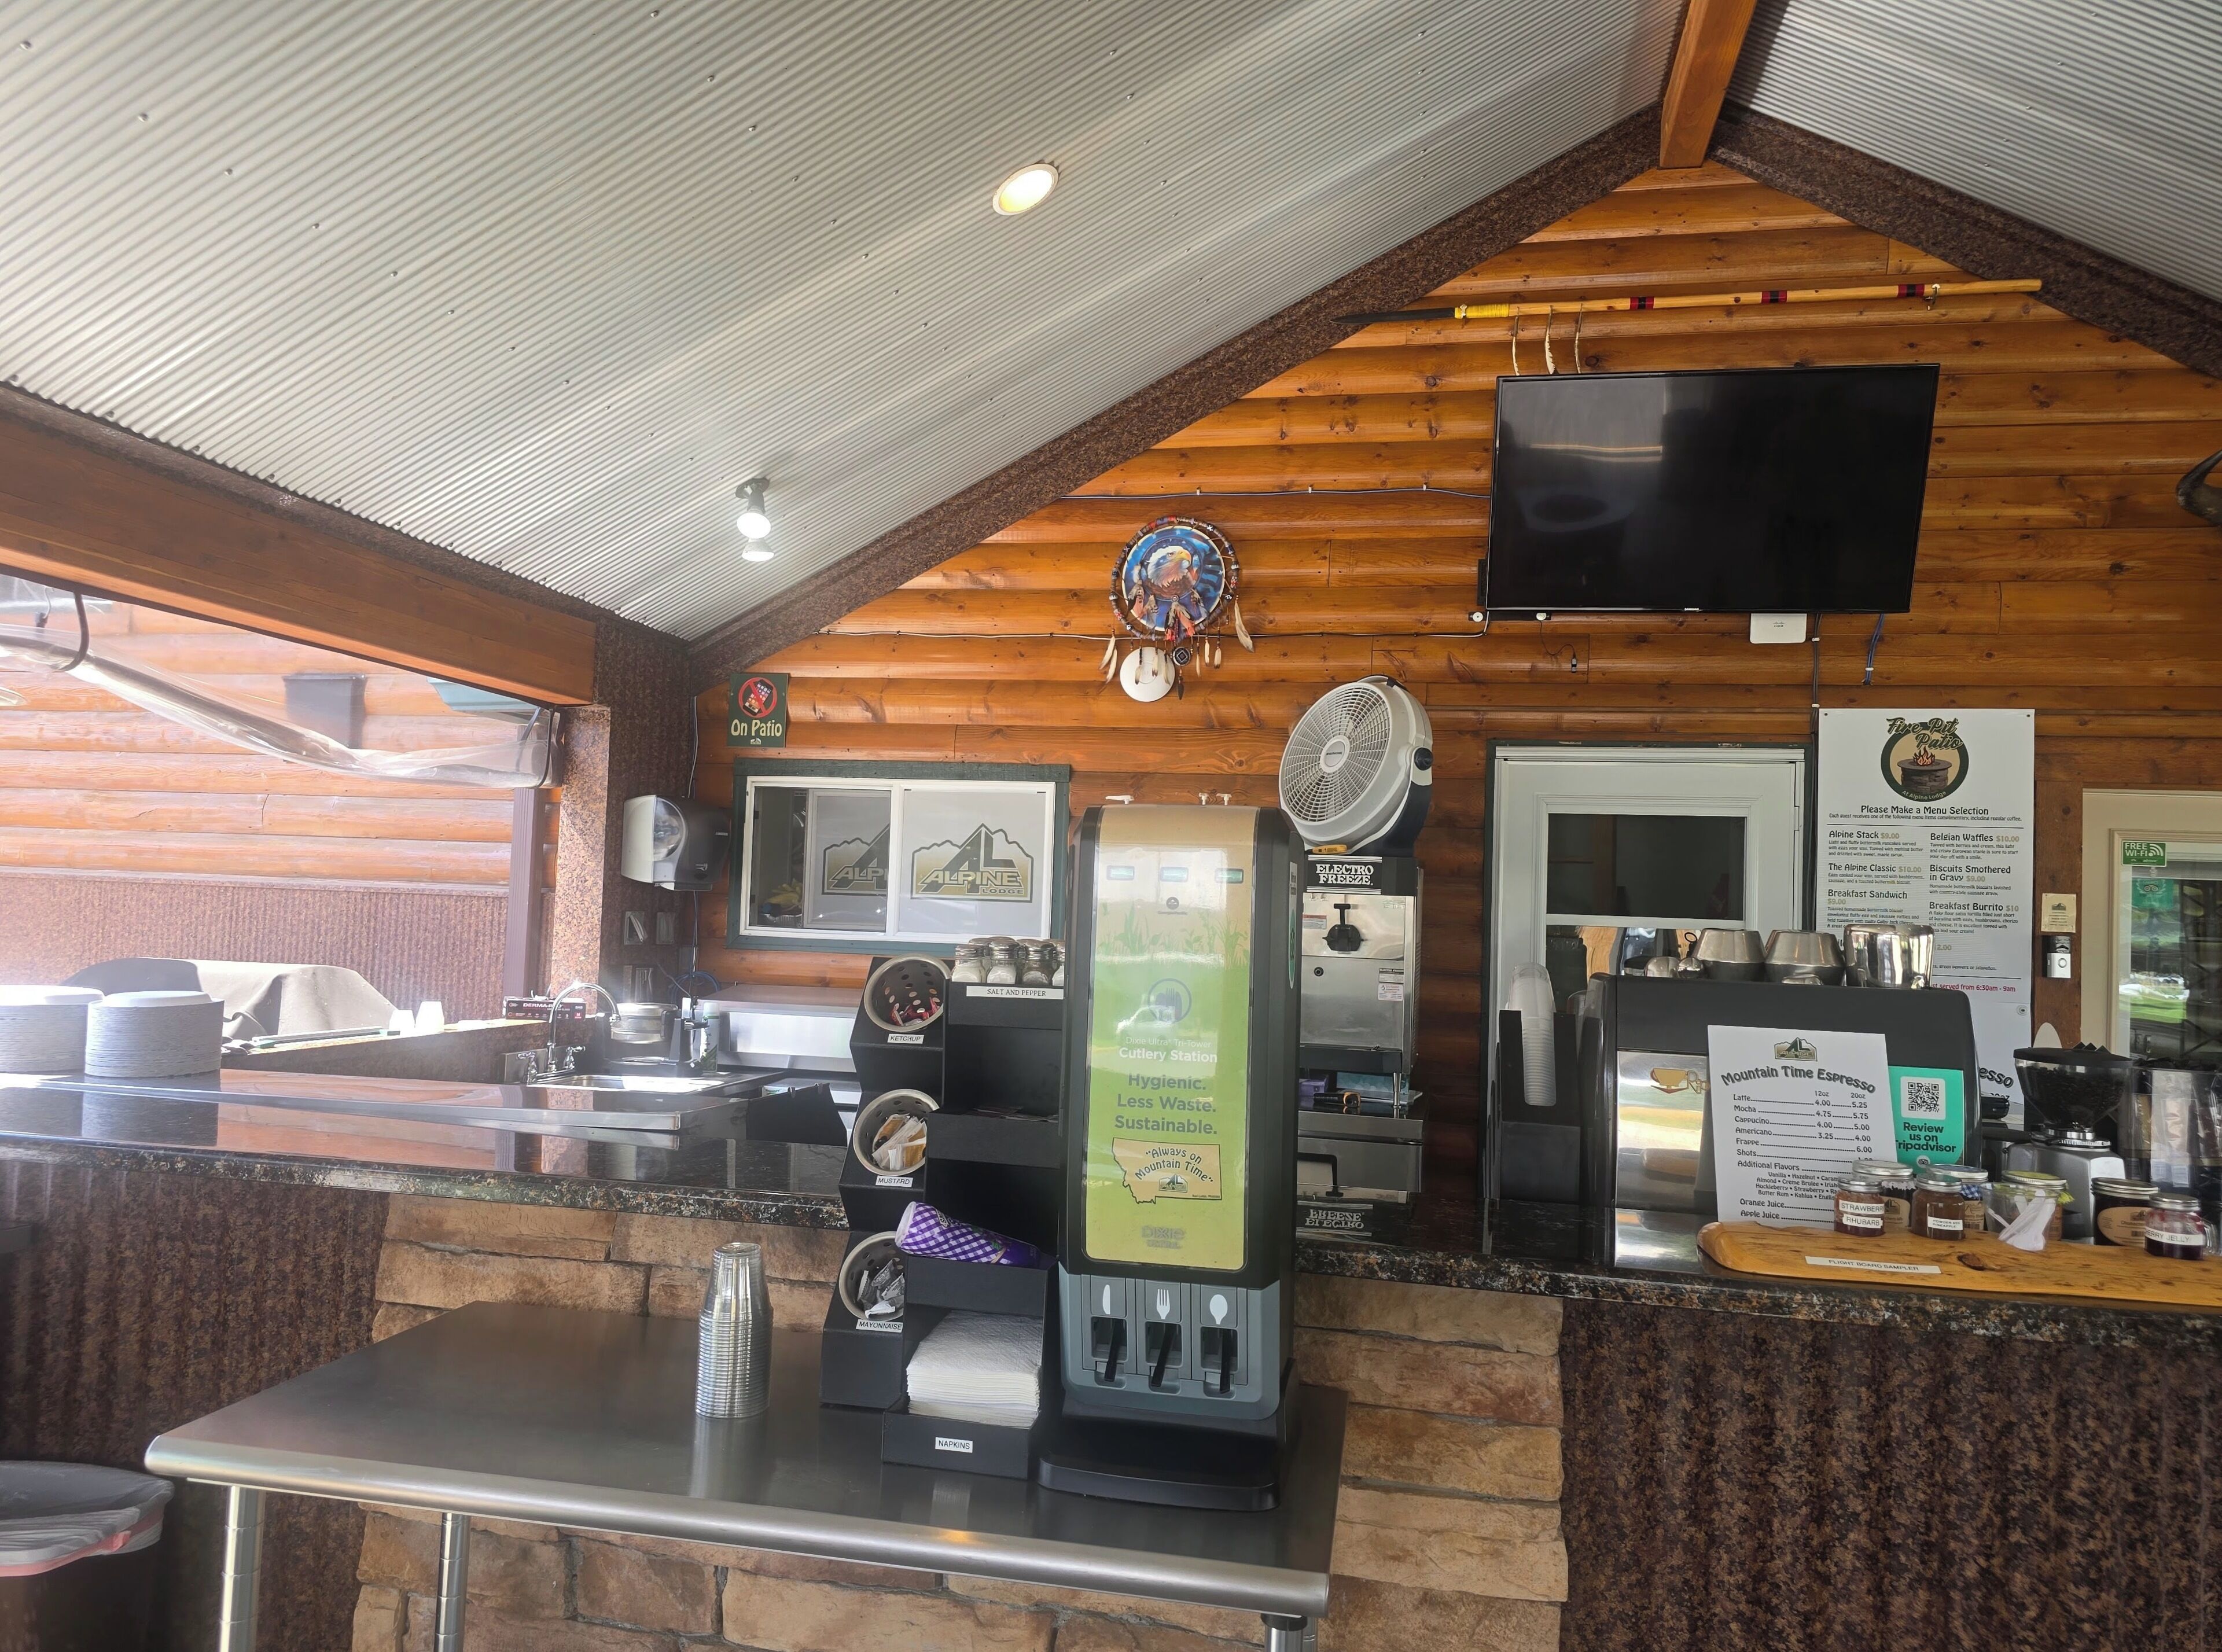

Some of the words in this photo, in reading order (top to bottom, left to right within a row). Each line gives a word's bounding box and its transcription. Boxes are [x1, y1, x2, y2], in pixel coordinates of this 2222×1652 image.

[731, 719, 748, 736] On
[752, 720, 782, 737] Patio
[1886, 718, 1922, 734] Fire
[1927, 718, 1959, 734] Pit
[1915, 733, 1963, 750] Patio
[1929, 792, 1946, 800] Lodge
[1950, 807, 1989, 815] Selection
[1963, 833, 1993, 841] Waffles
[1316, 864, 1374, 875] ELECTRO
[1829, 863, 1842, 871] The
[1930, 864, 1963, 873] Biscuits
[1965, 866, 2011, 874] Smothered
[832, 867, 888, 880] ALPI
[923, 870, 1021, 886] ALPINE
[1829, 889, 1866, 897] Breakfast
[1869, 891, 1907, 899] Sandwich
[1973, 903, 2003, 911] Burrito
[1175, 1039, 1212, 1047] Tri-Tower
[1119, 1047, 1167, 1062] Cutlery
[1171, 1050, 1217, 1062] Station
[1128, 1073, 1206, 1090] Hygienic.
[1721, 1066, 1779, 1086] Mountain
[1781, 1065, 1813, 1079] Time
[1817, 1068, 1876, 1094] Espresso
[1979, 1067, 2014, 1088] esso
[1117, 1094, 1153, 1109] Less
[1160, 1096, 1216, 1113] Waste.
[1114, 1115, 1217, 1135] Sustainable.
[1903, 1122, 1944, 1133] Review
[1735, 1127, 1772, 1135] Americano
[1737, 1138, 1760, 1146] Frappe
[1190, 1153, 1202, 1164] on
[1135, 1158, 1180, 1180] Mountain
[1738, 1160, 1772, 1169] Additional
[1740, 1198, 1765, 1206] Orange
[1842, 1203, 1883, 1212] STRAWBERR
[1846, 1217, 1879, 1226] RHUBARB
[859, 1321, 902, 1330] MAYONNAISE
[938, 1440, 970, 1449] NAPKINS
